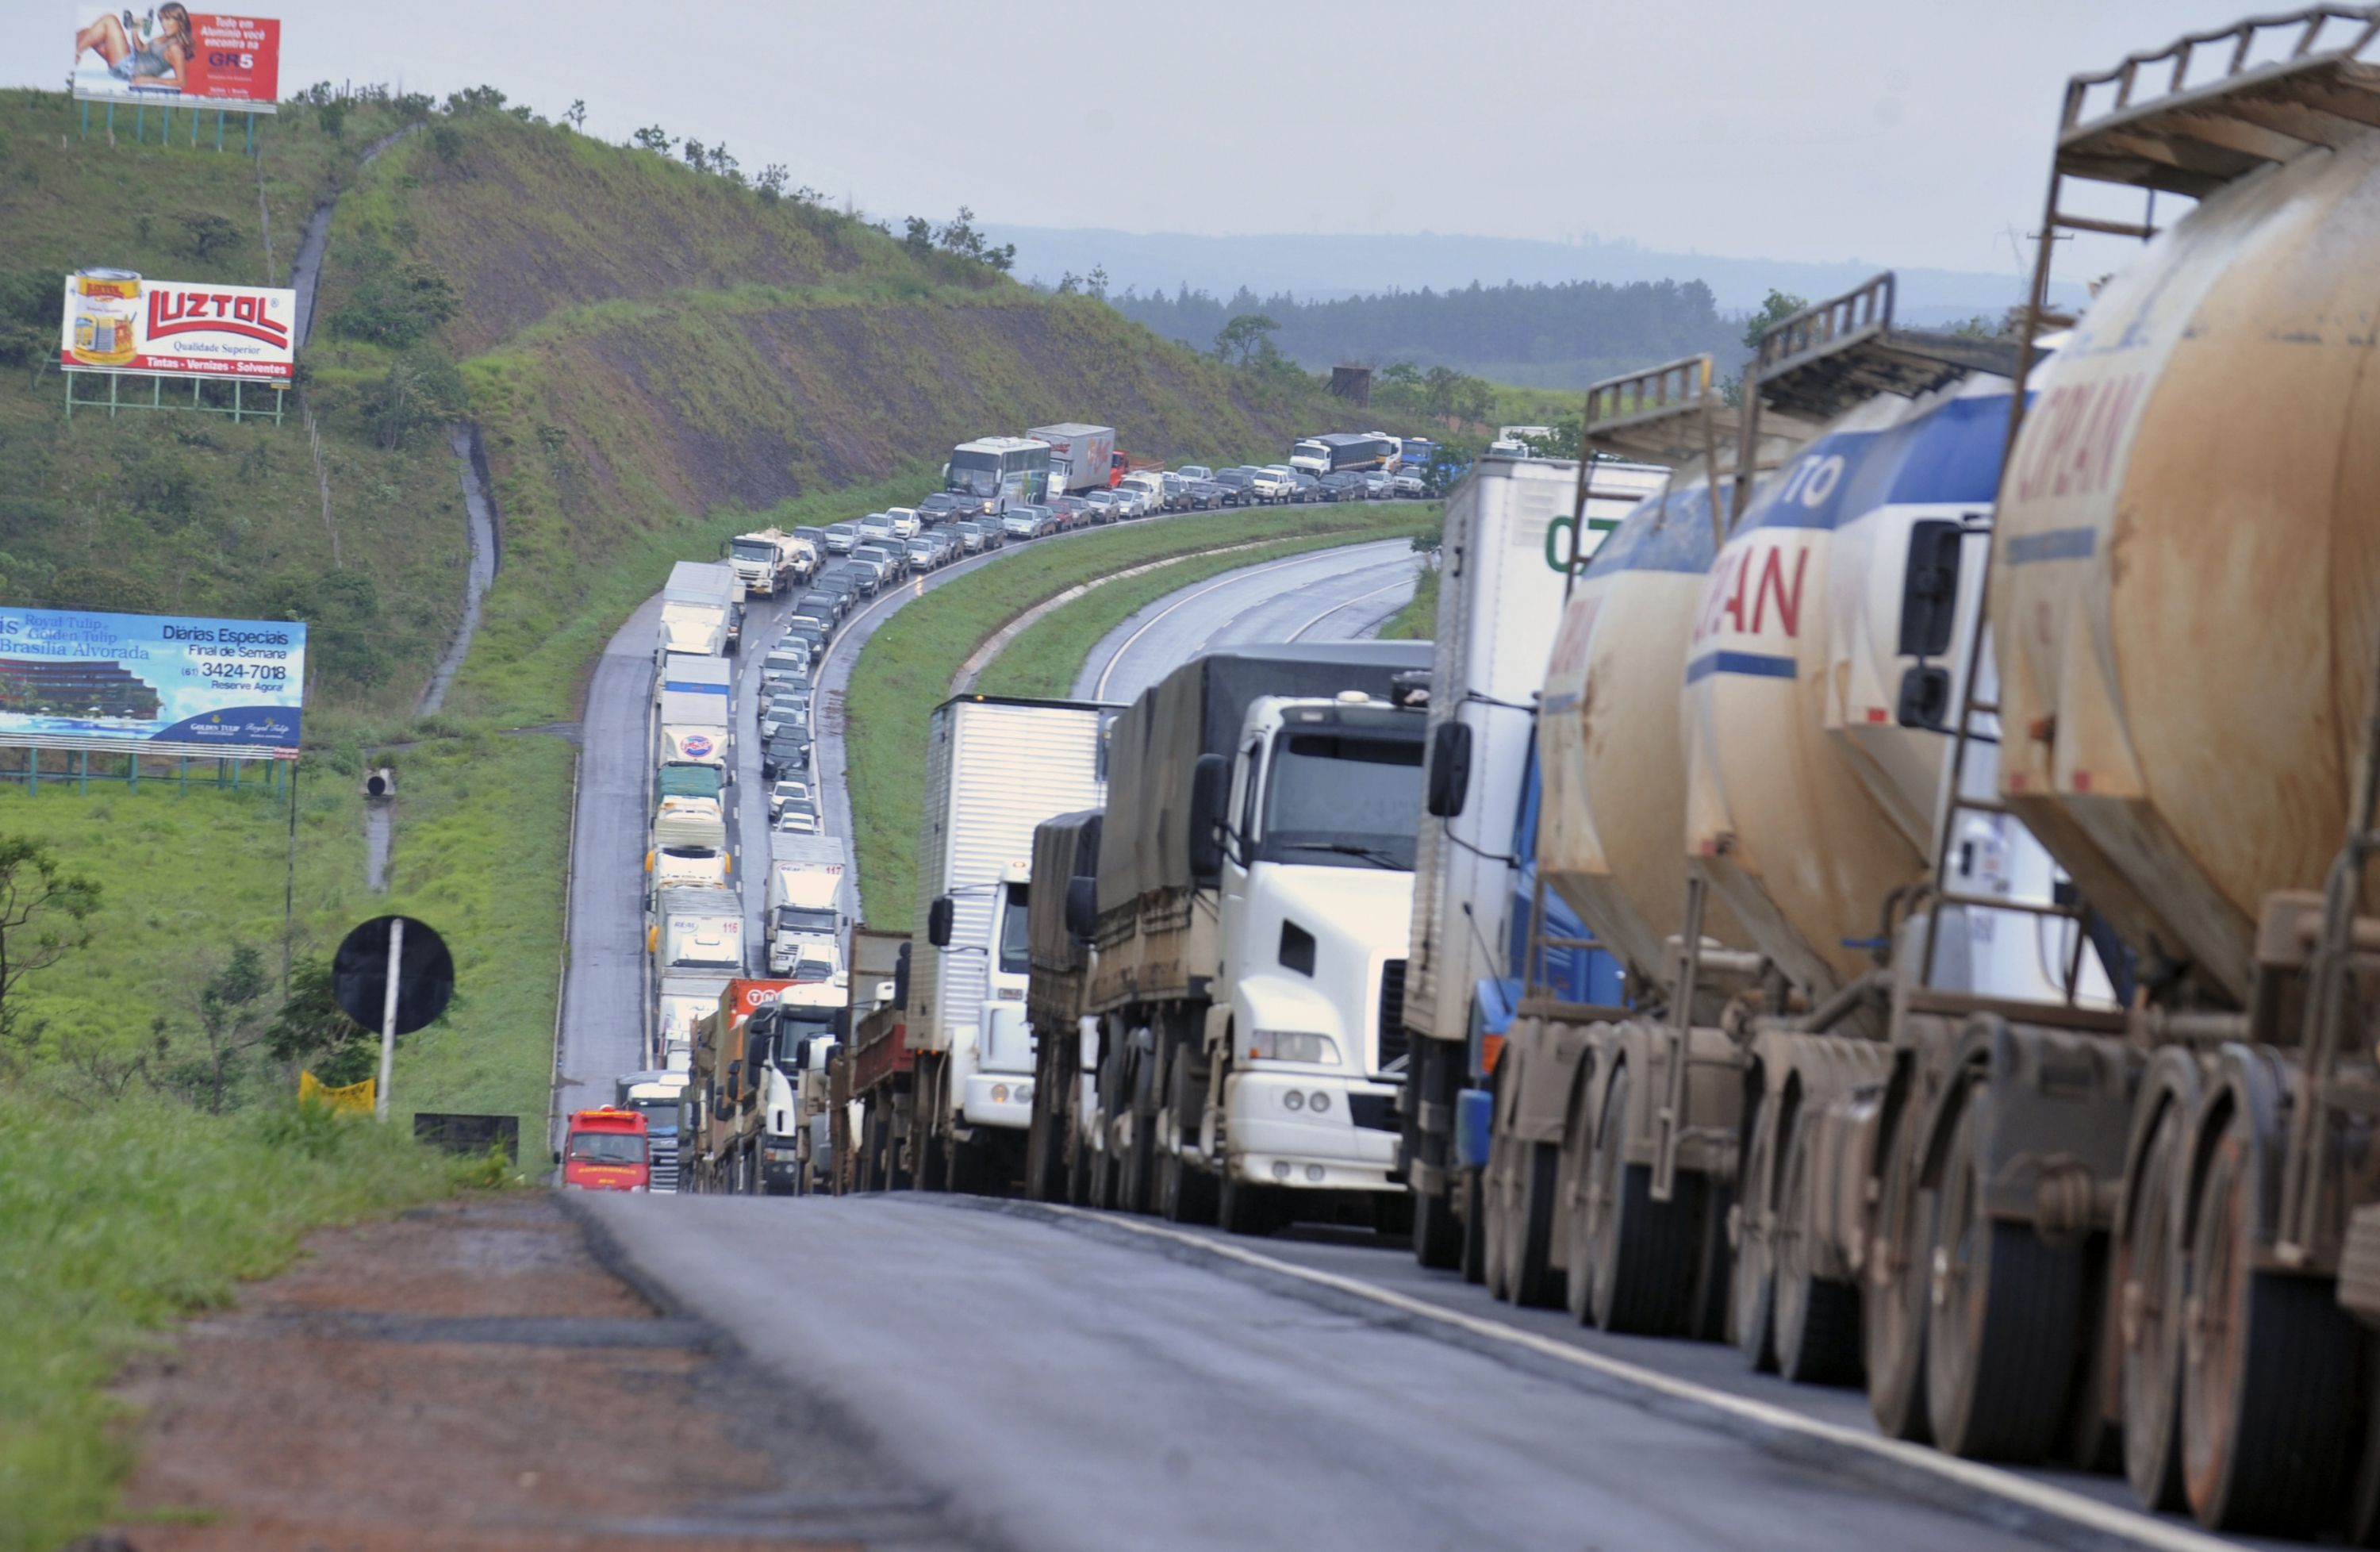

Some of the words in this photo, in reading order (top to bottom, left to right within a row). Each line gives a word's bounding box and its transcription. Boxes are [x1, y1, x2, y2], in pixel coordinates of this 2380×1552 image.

[209, 52, 253, 69] GR5
[147, 290, 288, 343] LUZTOL
[174, 341, 219, 353] Qualidade
[222, 344, 260, 355] Superior
[147, 357, 178, 368] Tintas
[187, 359, 228, 371] Vernizes
[237, 362, 286, 375] Solventes
[25, 614, 63, 629] Royal
[65, 617, 102, 631] Tulip
[27, 628, 77, 640] Golden
[83, 632, 117, 645] Tulip
[163, 624, 214, 643] Diárias
[219, 628, 289, 647] Especiais
[72, 643, 149, 659] Alvorada
[189, 644, 217, 656] Final
[220, 646, 235, 657] de
[239, 647, 286, 659] Semana
[202, 662, 286, 680] 3424-7018
[211, 680, 251, 690] Reserve
